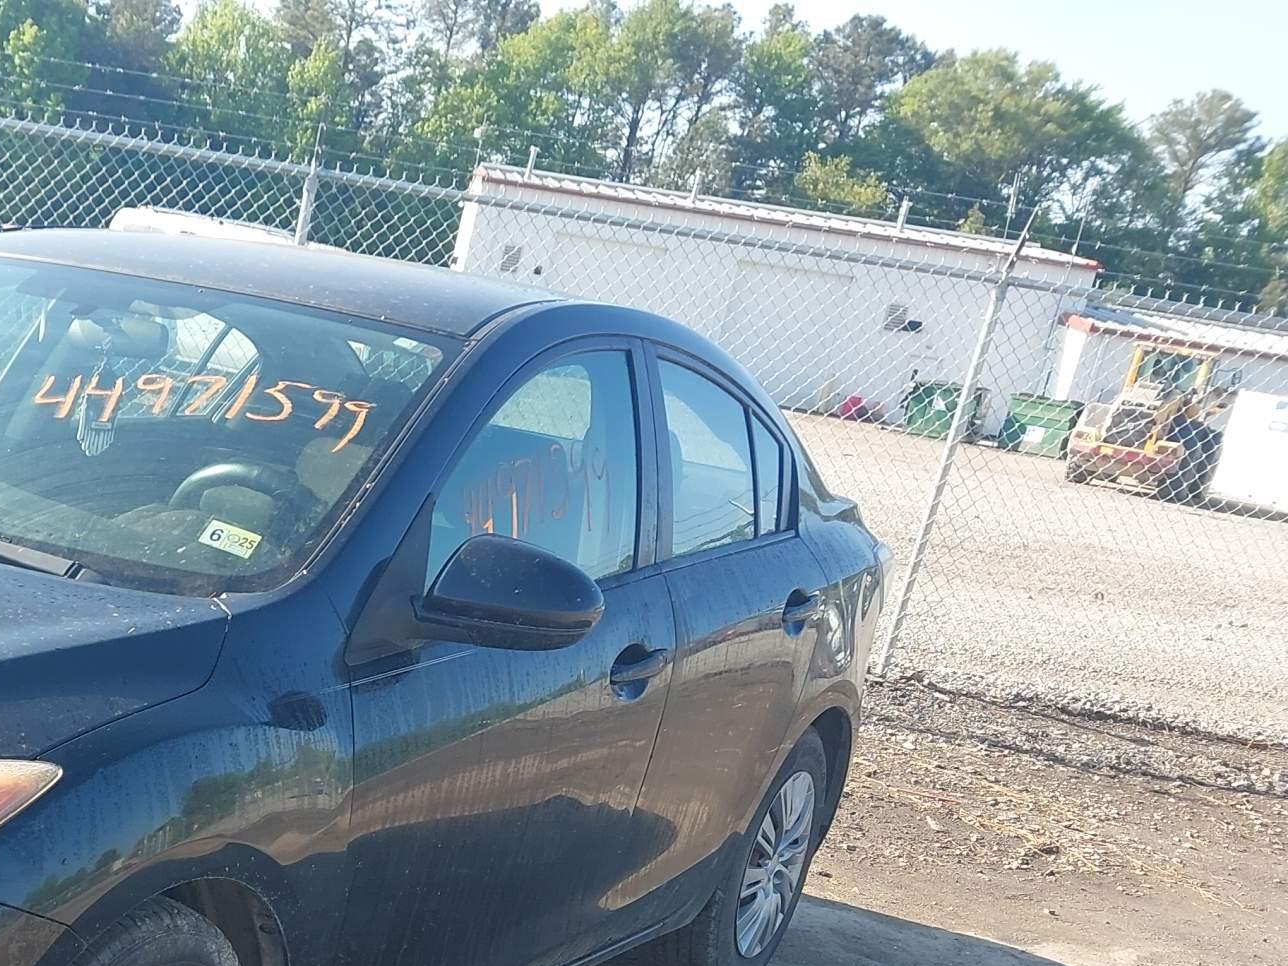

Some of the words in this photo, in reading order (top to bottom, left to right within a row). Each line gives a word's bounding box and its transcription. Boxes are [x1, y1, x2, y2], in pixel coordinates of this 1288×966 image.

[33, 373, 377, 453] 44971599
[210, 529, 224, 541] 6
[239, 537, 256, 549] 25
